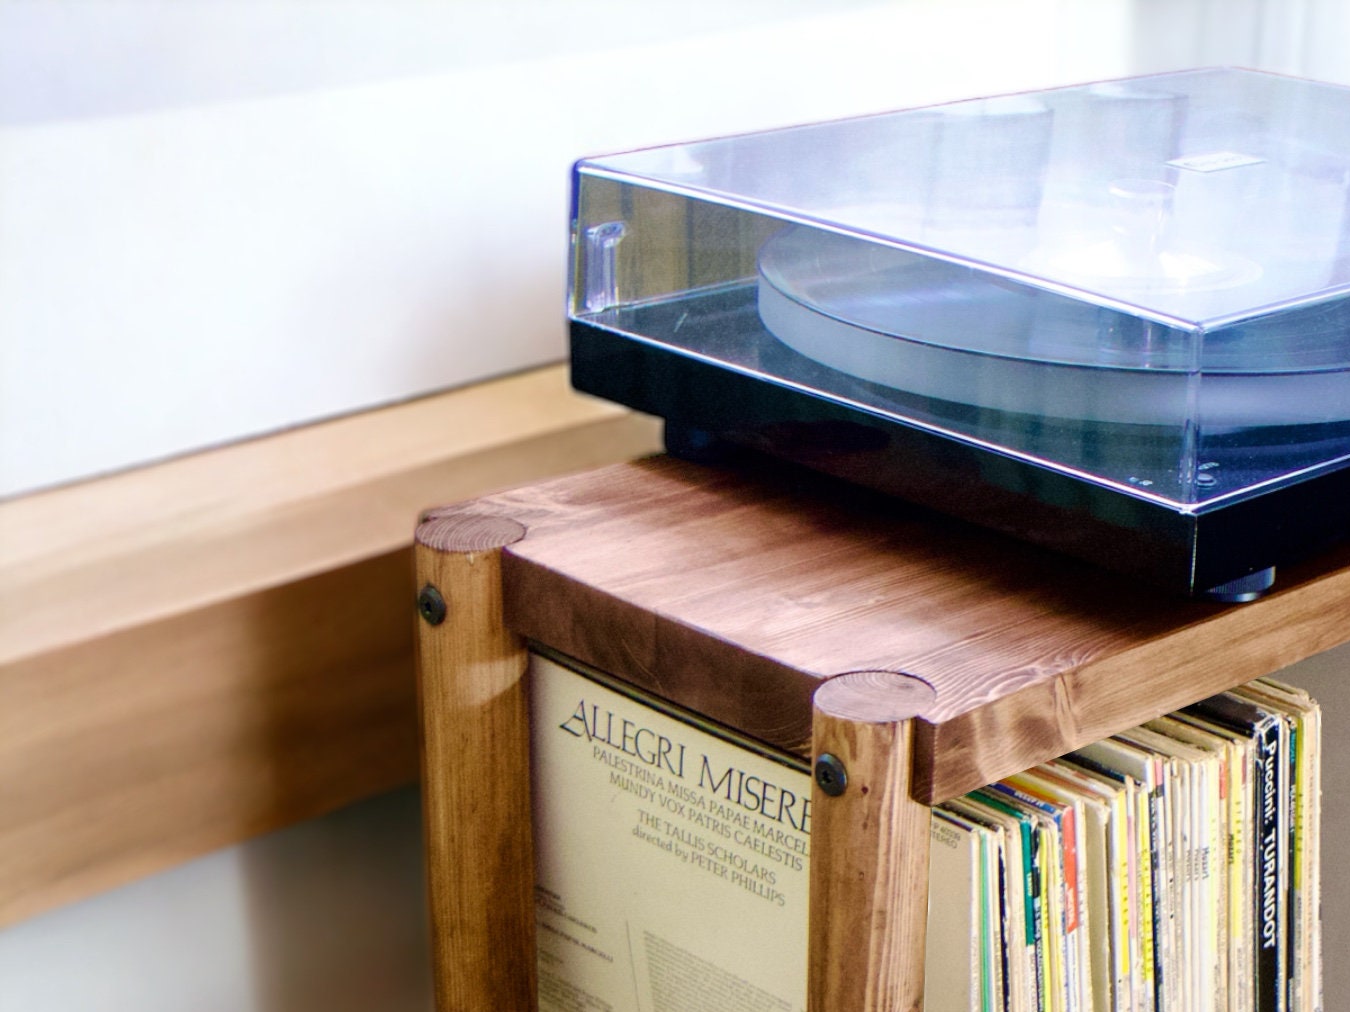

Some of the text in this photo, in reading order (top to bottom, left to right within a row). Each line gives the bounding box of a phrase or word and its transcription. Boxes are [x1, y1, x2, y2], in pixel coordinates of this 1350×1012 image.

[559, 699, 686, 778] ALLEGRI
[593, 745, 665, 790] PALESTRINA
[667, 781, 706, 809] MISSA
[709, 796, 750, 830] PAPAE
[609, 771, 804, 872] MUNDY VOX PATRIS CAELESTIS
[632, 826, 785, 907] directed by PETER PHILLIPS
[637, 808, 777, 885] THE TALLIS SCHOLARS
[1262, 739, 1278, 950] Puccini: TURANDOT
